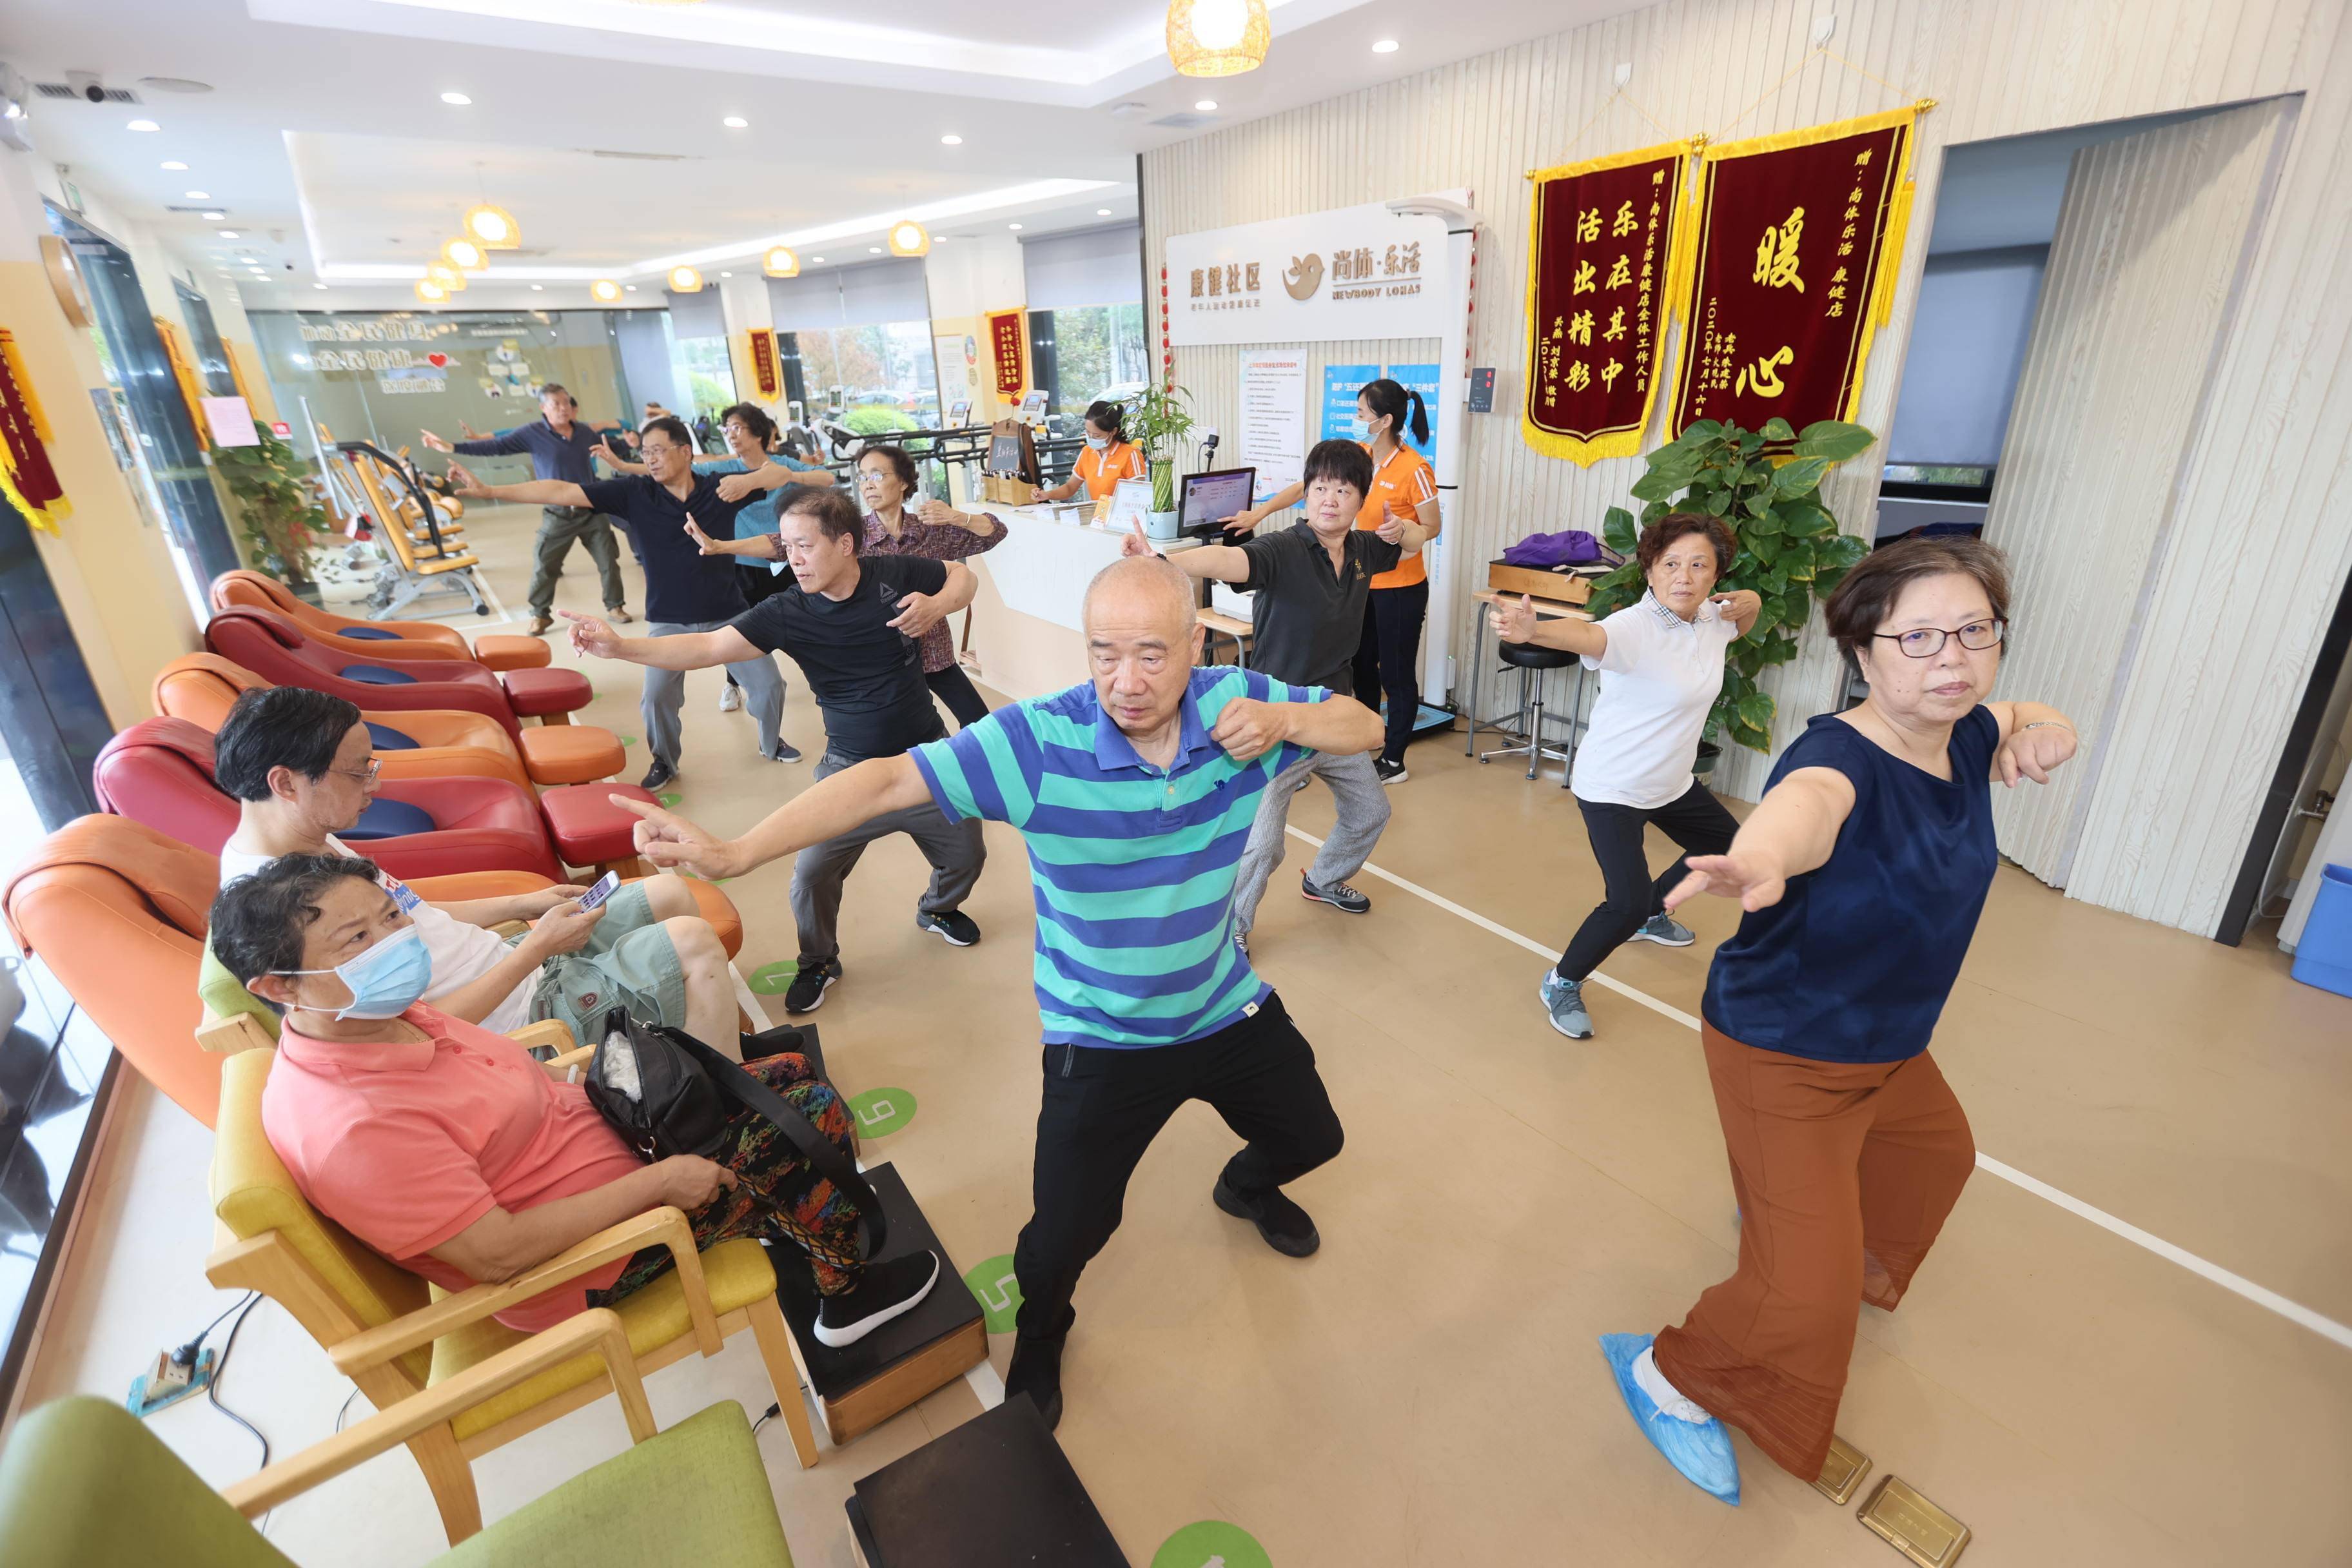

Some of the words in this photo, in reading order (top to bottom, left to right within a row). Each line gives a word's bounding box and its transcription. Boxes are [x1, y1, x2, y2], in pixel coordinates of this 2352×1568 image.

[1190, 262, 1261, 298] 康健社区
[1332, 241, 1422, 281] 尚体·乐活
[1332, 288, 1382, 300] NEWBODY
[1386, 284, 1422, 297] LOHAS
[1563, 208, 1603, 393] 活出精彩
[1601, 201, 1639, 394] 乐在其中
[1736, 206, 1805, 398] 暖心
[1825, 266, 1848, 317] 康健店
